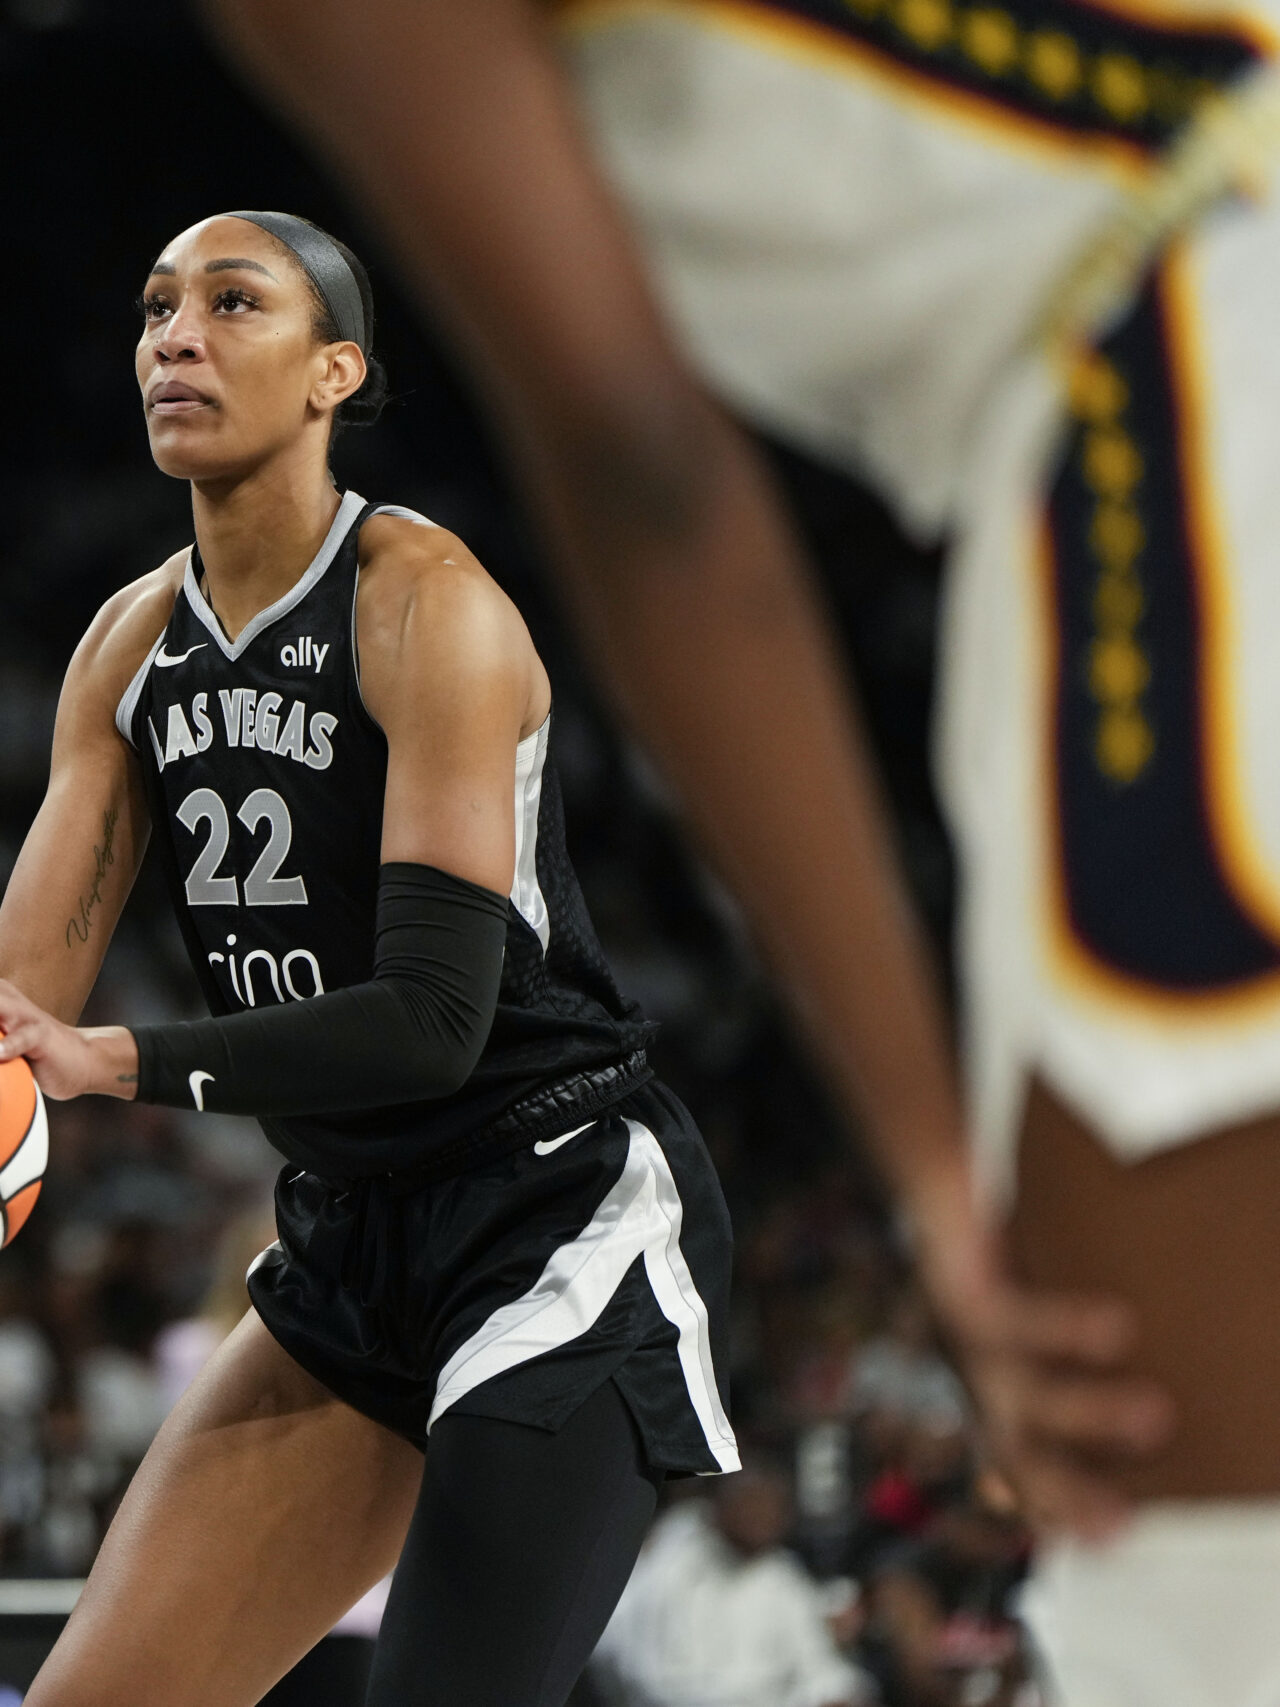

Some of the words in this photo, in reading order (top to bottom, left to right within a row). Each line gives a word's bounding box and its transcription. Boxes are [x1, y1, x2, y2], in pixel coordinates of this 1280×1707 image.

[280, 636, 330, 674] ally
[218, 688, 339, 770] VEGAS
[176, 788, 308, 905] 22
